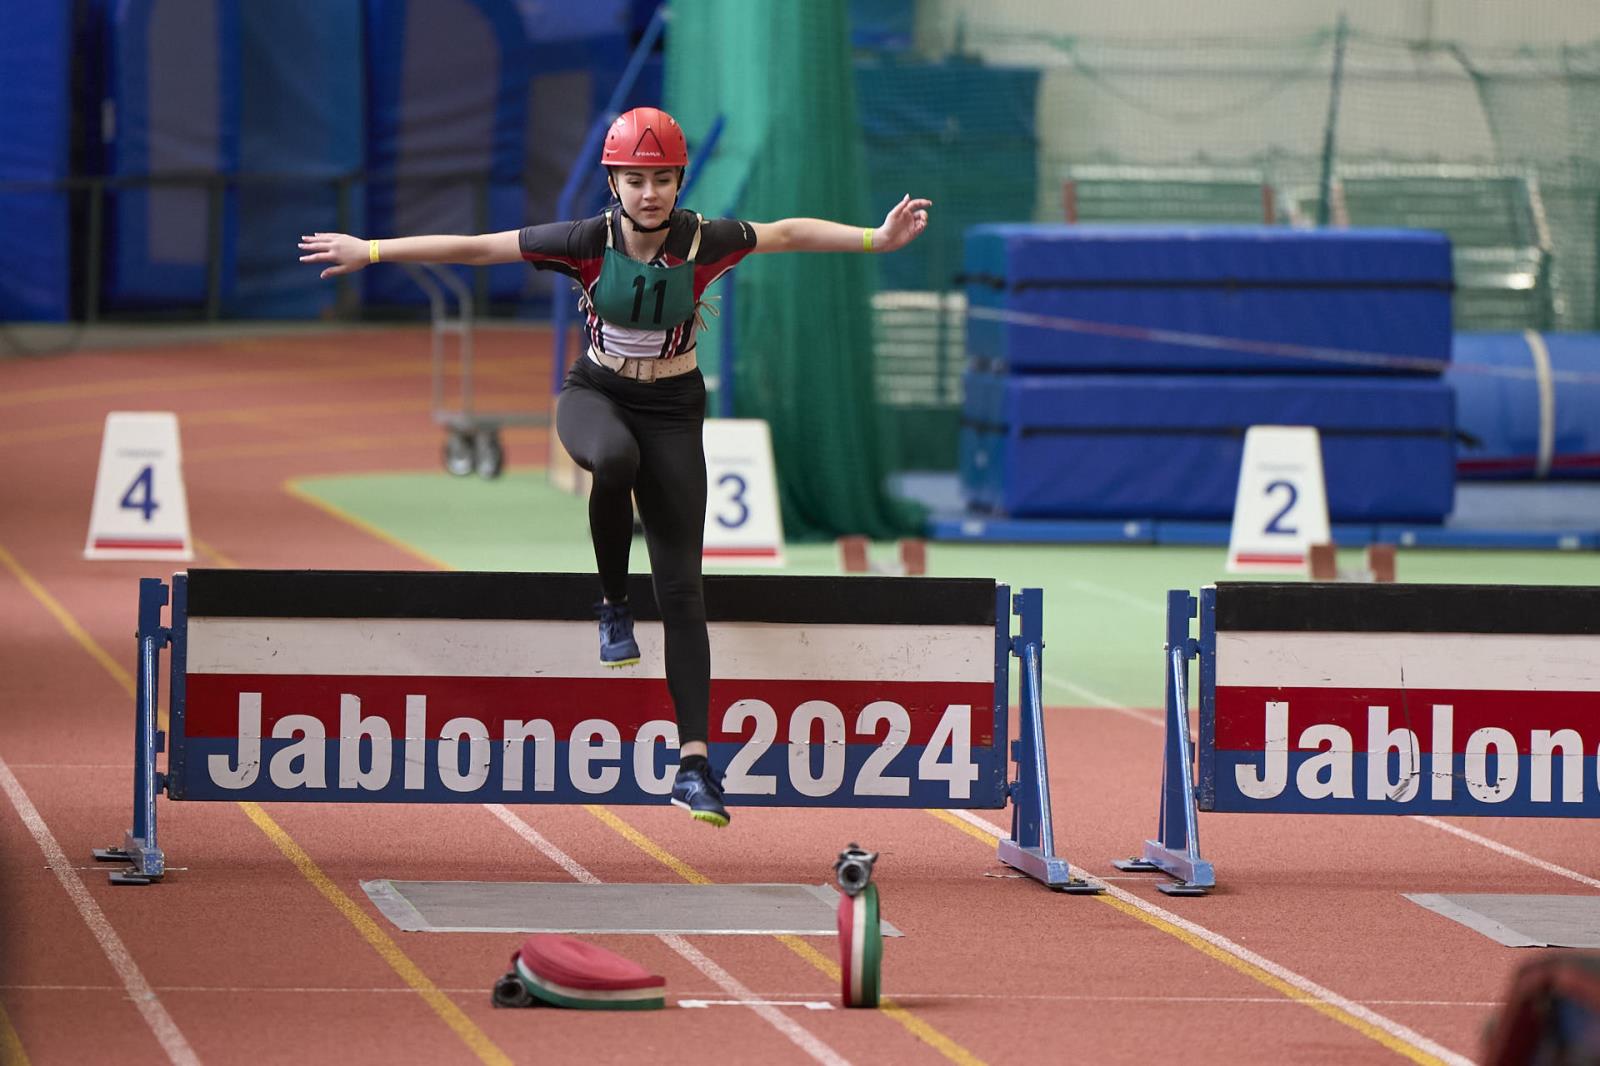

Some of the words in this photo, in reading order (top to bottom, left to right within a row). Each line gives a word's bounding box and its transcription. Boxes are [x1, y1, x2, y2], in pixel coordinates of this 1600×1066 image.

[631, 275, 667, 324] 11
[120, 464, 159, 521] 4
[716, 473, 749, 529] 3
[1264, 481, 1298, 534] 2
[208, 692, 680, 796] Jablonec
[721, 698, 979, 799] 2024
[1235, 701, 1600, 803] Jablon
